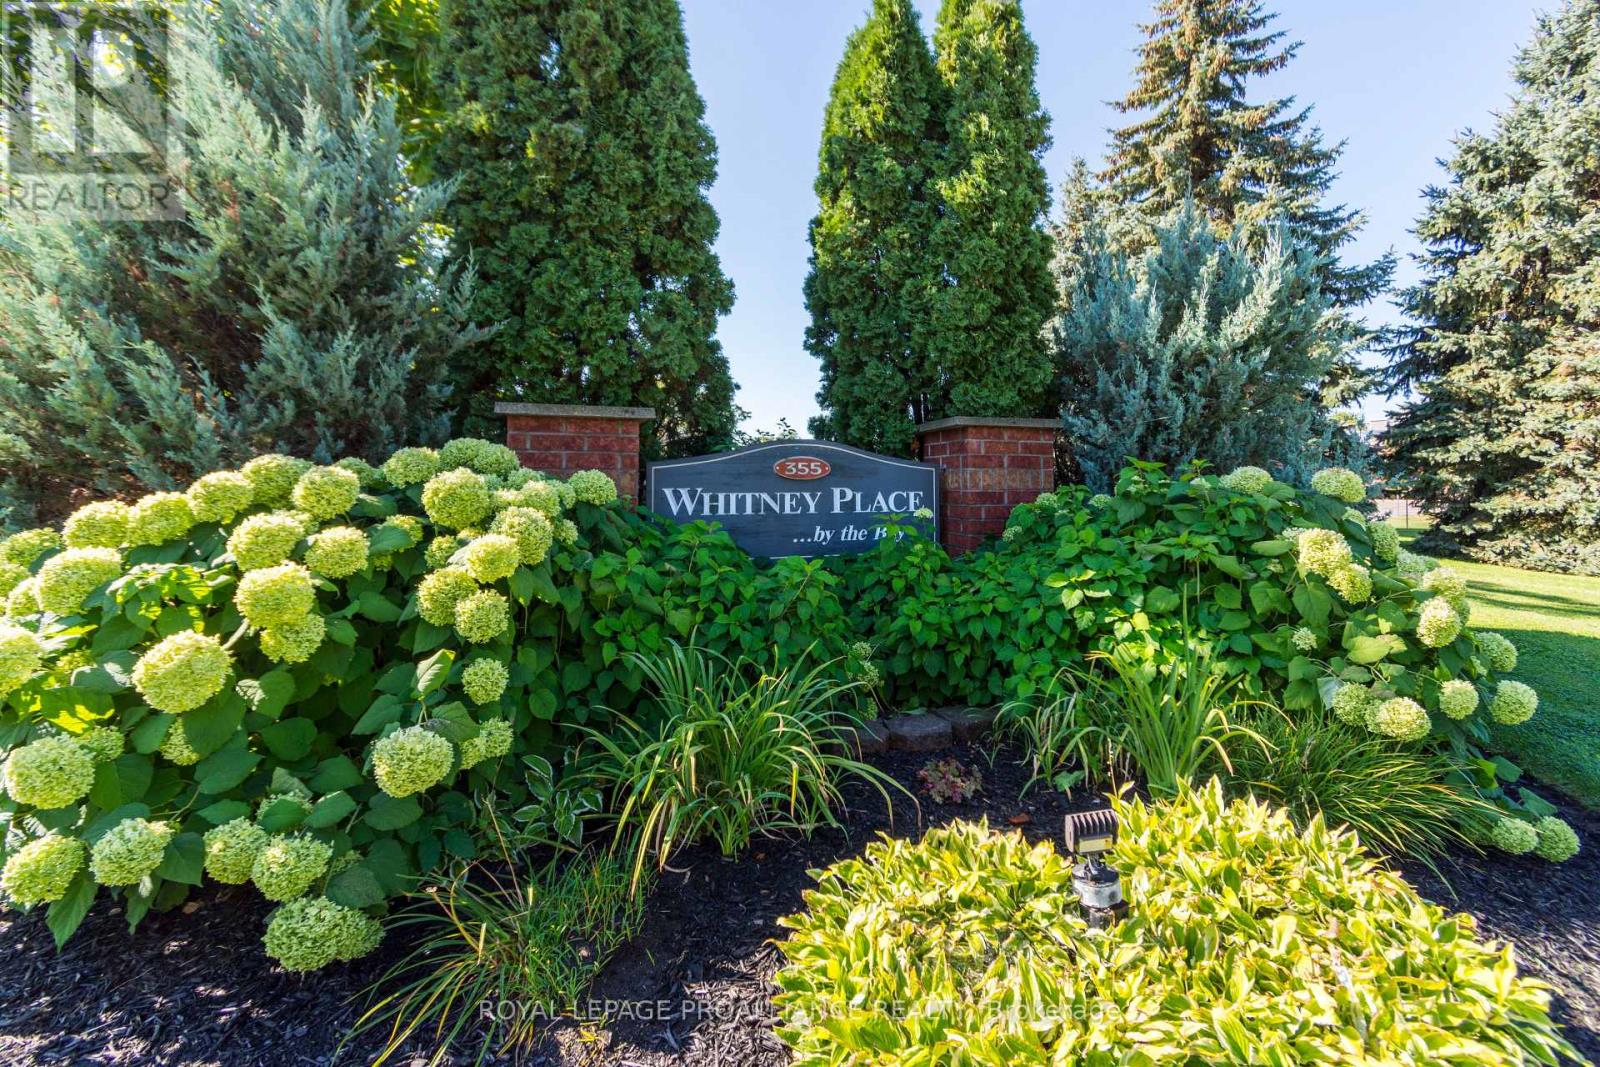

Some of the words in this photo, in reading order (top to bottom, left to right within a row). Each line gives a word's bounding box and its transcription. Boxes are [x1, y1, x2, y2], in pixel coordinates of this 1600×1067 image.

[785, 462, 822, 476] 355
[662, 488, 822, 516] WHITNEY
[830, 487, 924, 514] PLACE
[840, 525, 868, 541] the
[874, 527, 905, 543] By
